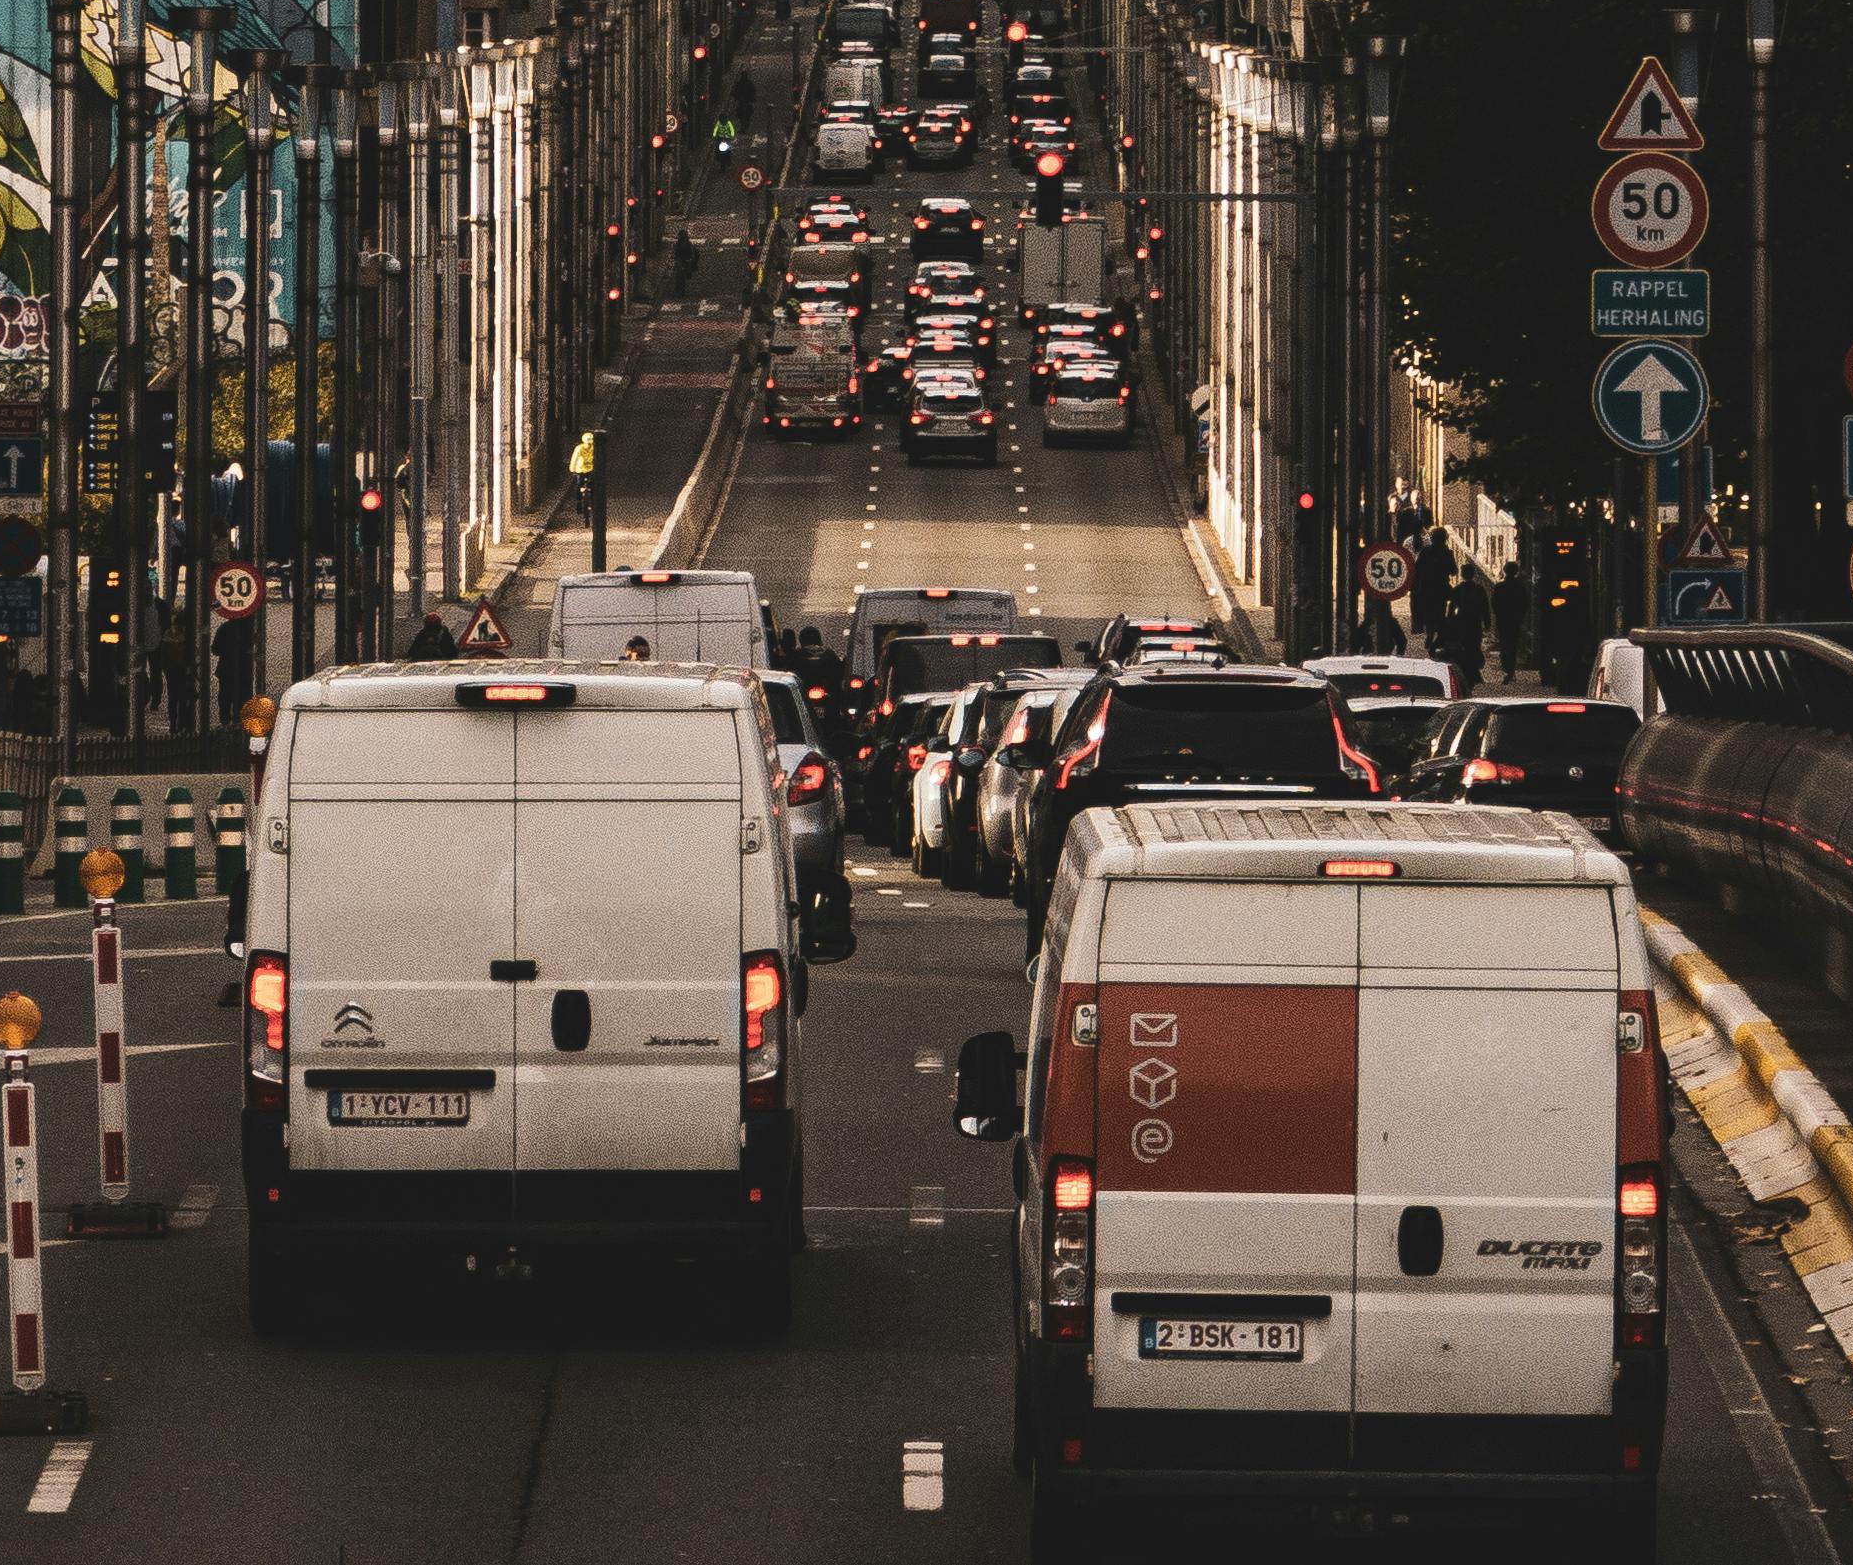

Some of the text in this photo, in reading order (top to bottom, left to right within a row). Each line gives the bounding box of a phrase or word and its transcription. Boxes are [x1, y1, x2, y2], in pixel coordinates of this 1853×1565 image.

[1622, 182, 1680, 220] 50
[1636, 225, 1665, 242] km
[1612, 280, 1689, 298] RAPPEL
[1597, 309, 1705, 328] HERHALING
[1370, 557, 1403, 579] 50
[220, 576, 252, 597] 50
[1476, 1239, 1603, 1256] DUCATO
[1522, 1256, 1592, 1269] MAXI
